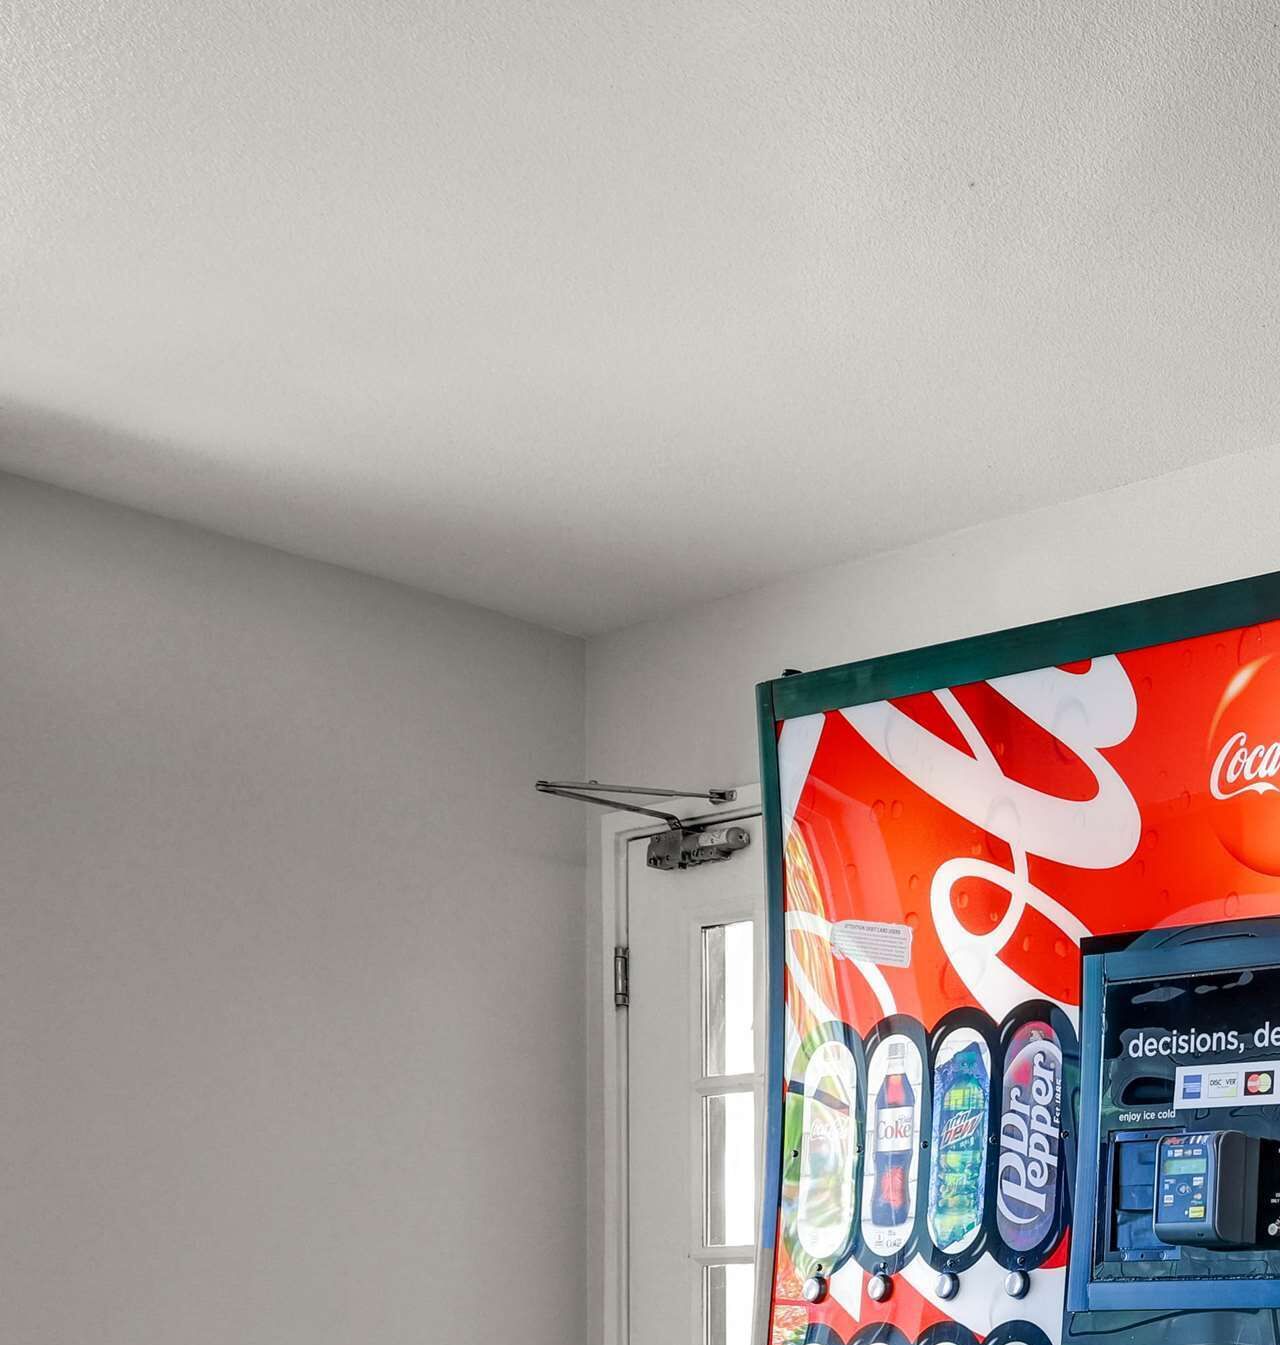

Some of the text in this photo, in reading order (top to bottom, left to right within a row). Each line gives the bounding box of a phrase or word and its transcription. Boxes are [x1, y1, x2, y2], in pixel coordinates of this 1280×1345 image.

[1128, 1028, 1245, 1058] decisions,
[1119, 1108, 1176, 1123] enjoy ice cold
